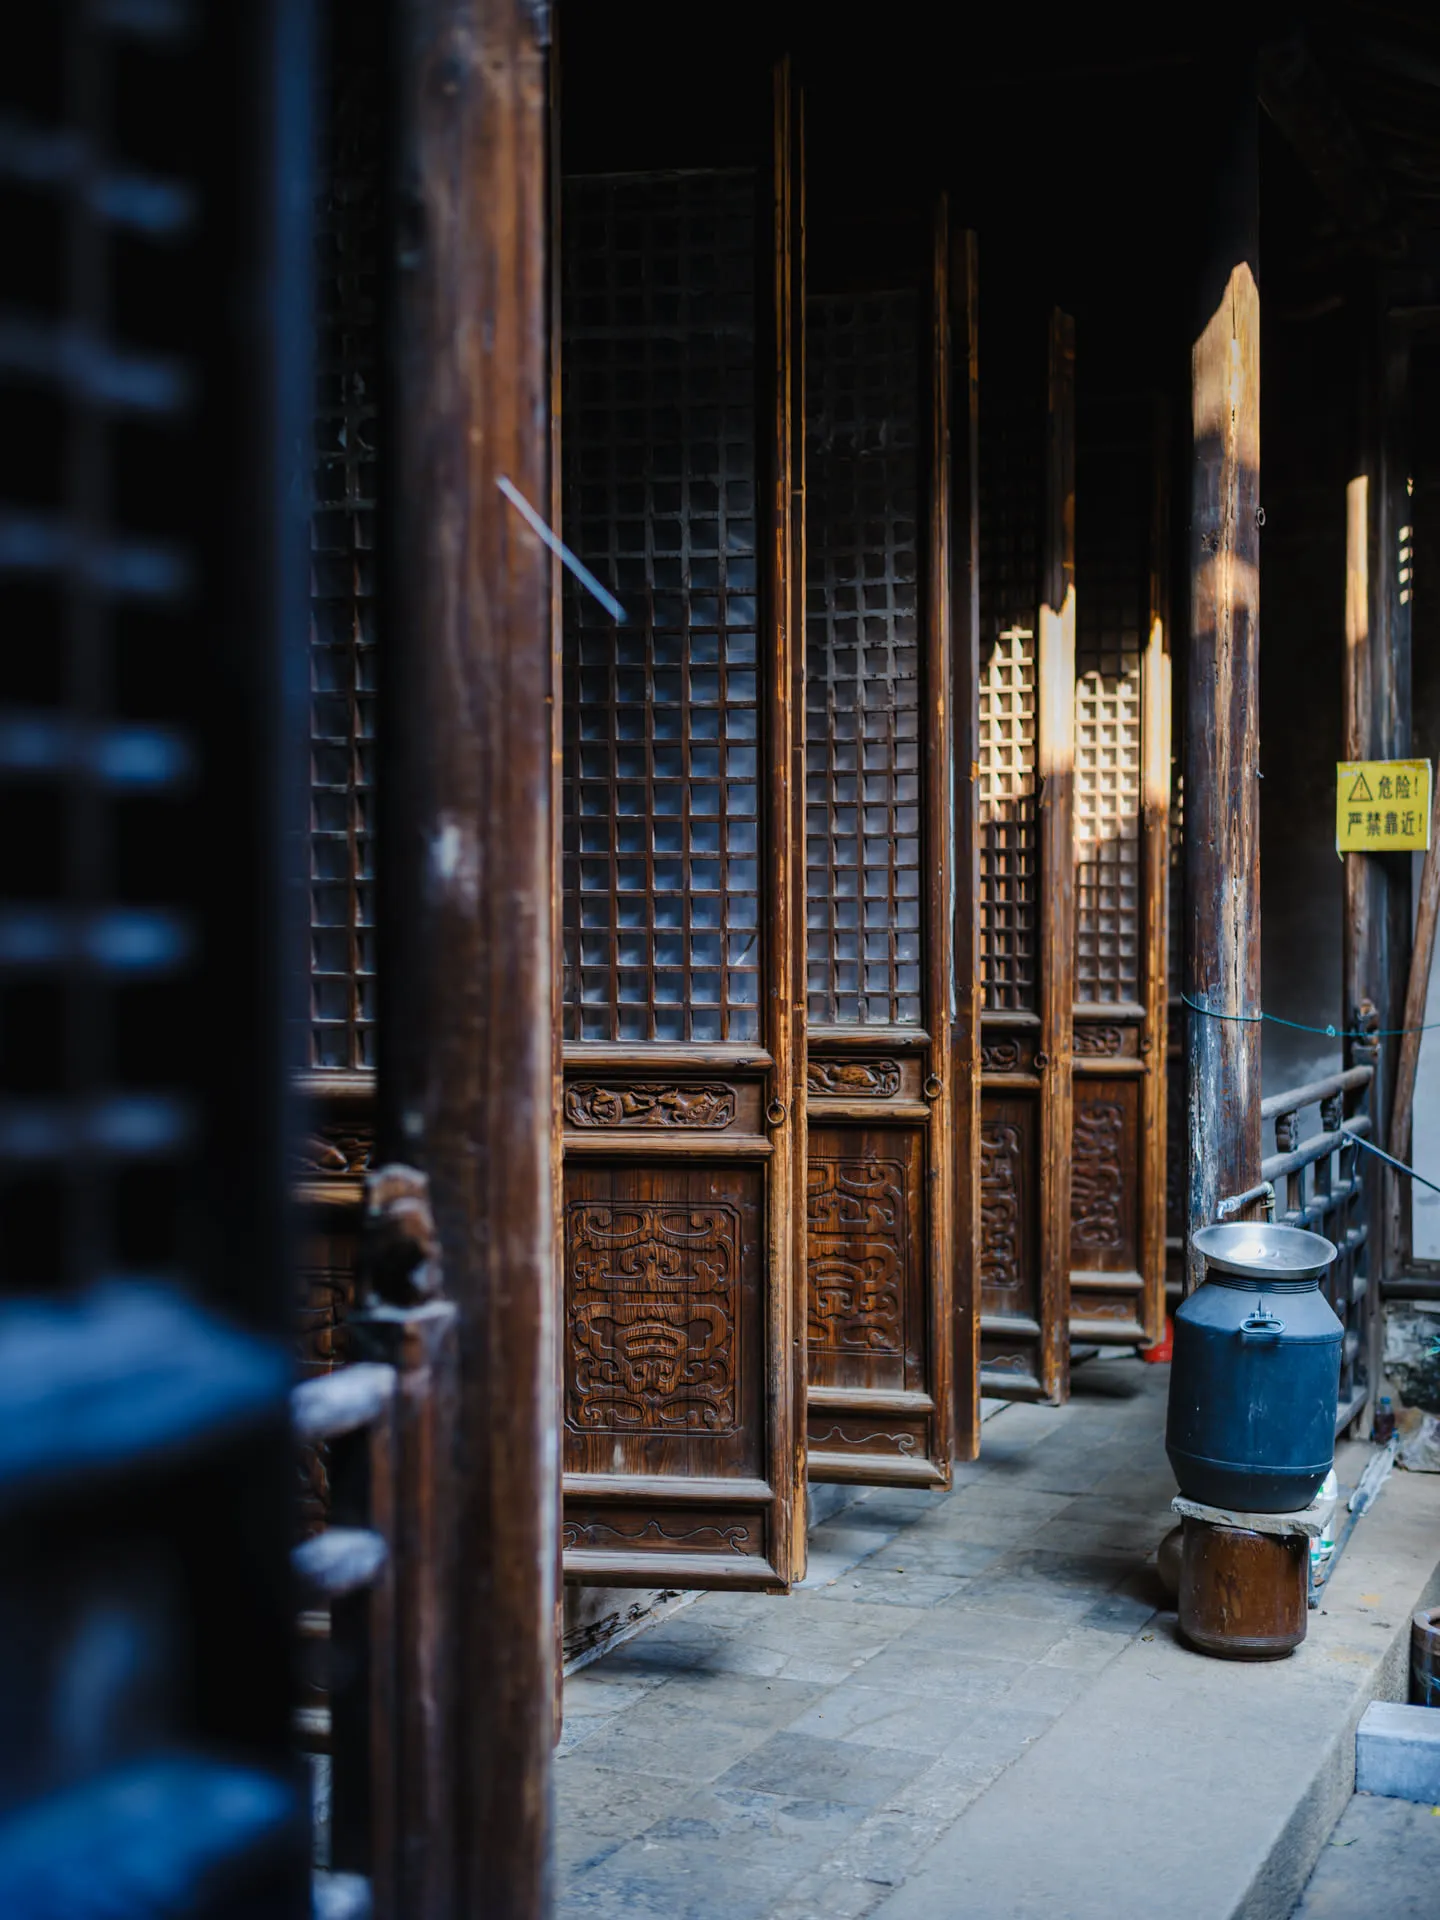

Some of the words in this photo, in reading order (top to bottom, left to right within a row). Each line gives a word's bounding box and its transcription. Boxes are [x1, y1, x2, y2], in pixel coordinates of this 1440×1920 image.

[1378, 775, 1418, 800] 危险!
[1347, 810, 1422, 836] 严禁靠近!
